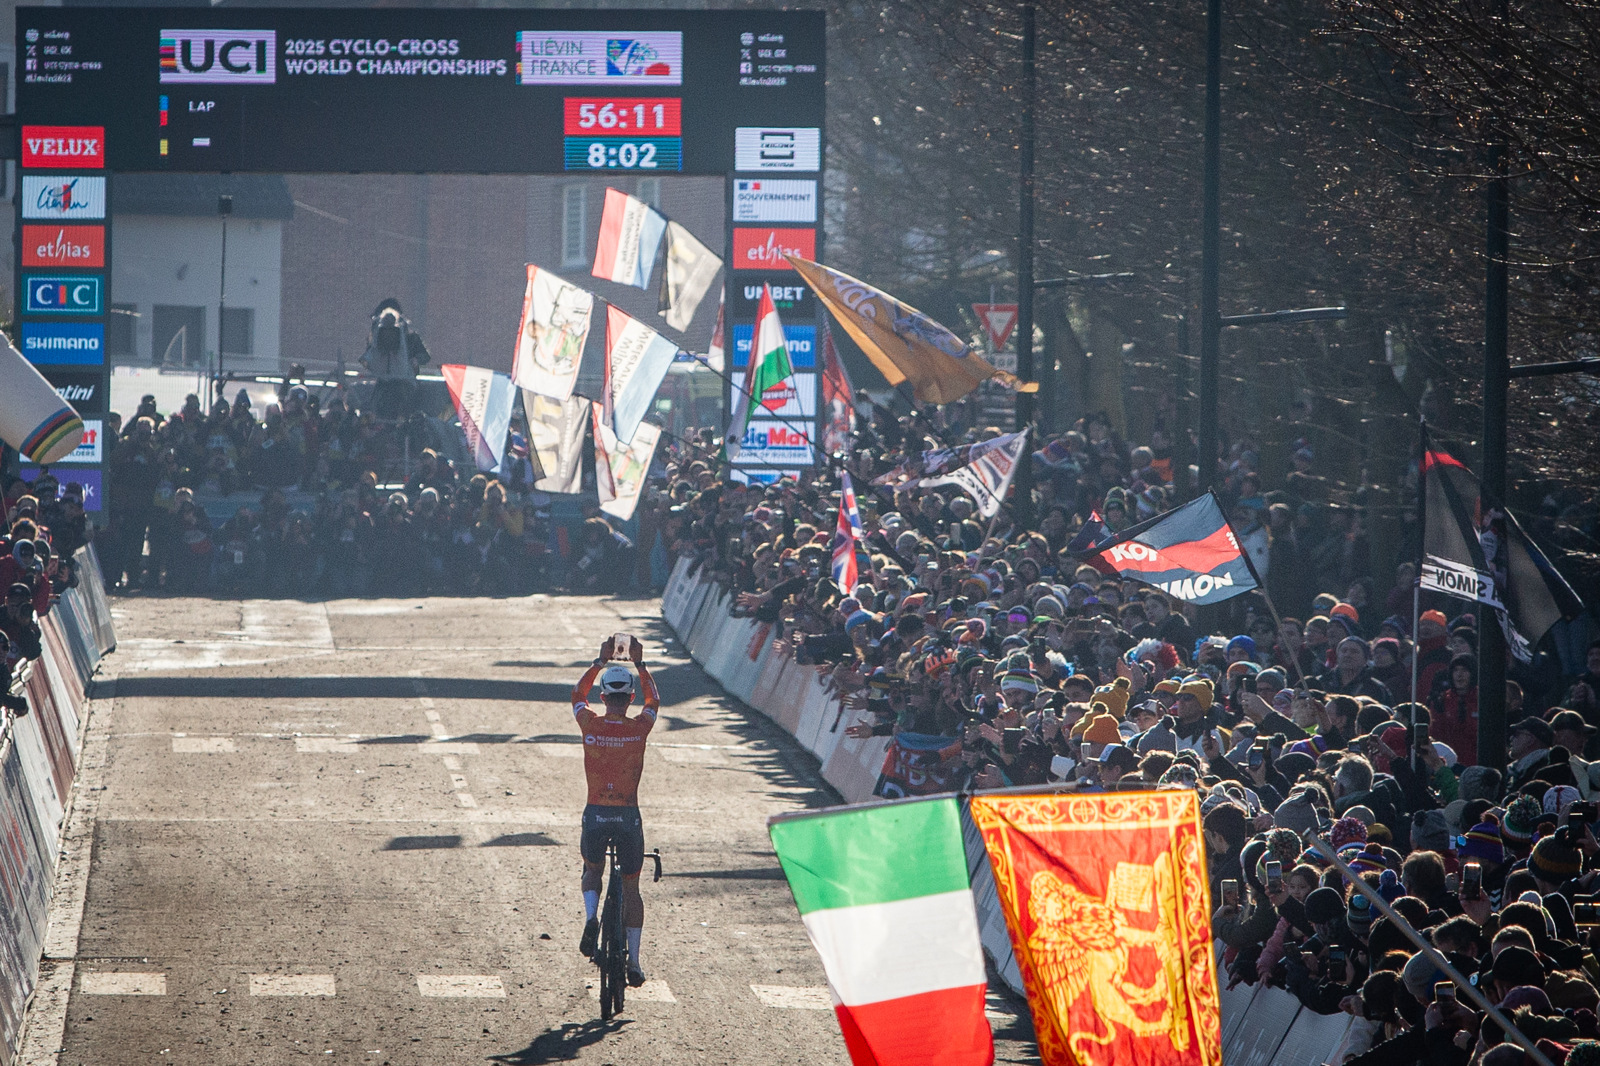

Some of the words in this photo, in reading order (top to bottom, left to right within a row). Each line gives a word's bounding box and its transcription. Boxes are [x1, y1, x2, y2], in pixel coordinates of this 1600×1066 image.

[285, 39, 325, 55] 2025
[329, 39, 460, 56] CYCLO-CROSS
[530, 37, 583, 56] LIÉVIN
[181, 39, 267, 73] UCI
[285, 59, 352, 74] WORLD
[356, 58, 508, 76] CHAMPIONSHIPS
[530, 59, 597, 76] FRANCE
[188, 100, 216, 112] LAP
[578, 102, 665, 129] 56:11
[27, 138, 98, 156] VELUX
[587, 142, 658, 168] 8:02
[738, 192, 811, 202] GOUVERNEMENT
[36, 228, 91, 263] ethias
[36, 283, 91, 306] CIC
[26, 336, 100, 350] SHIMANO
